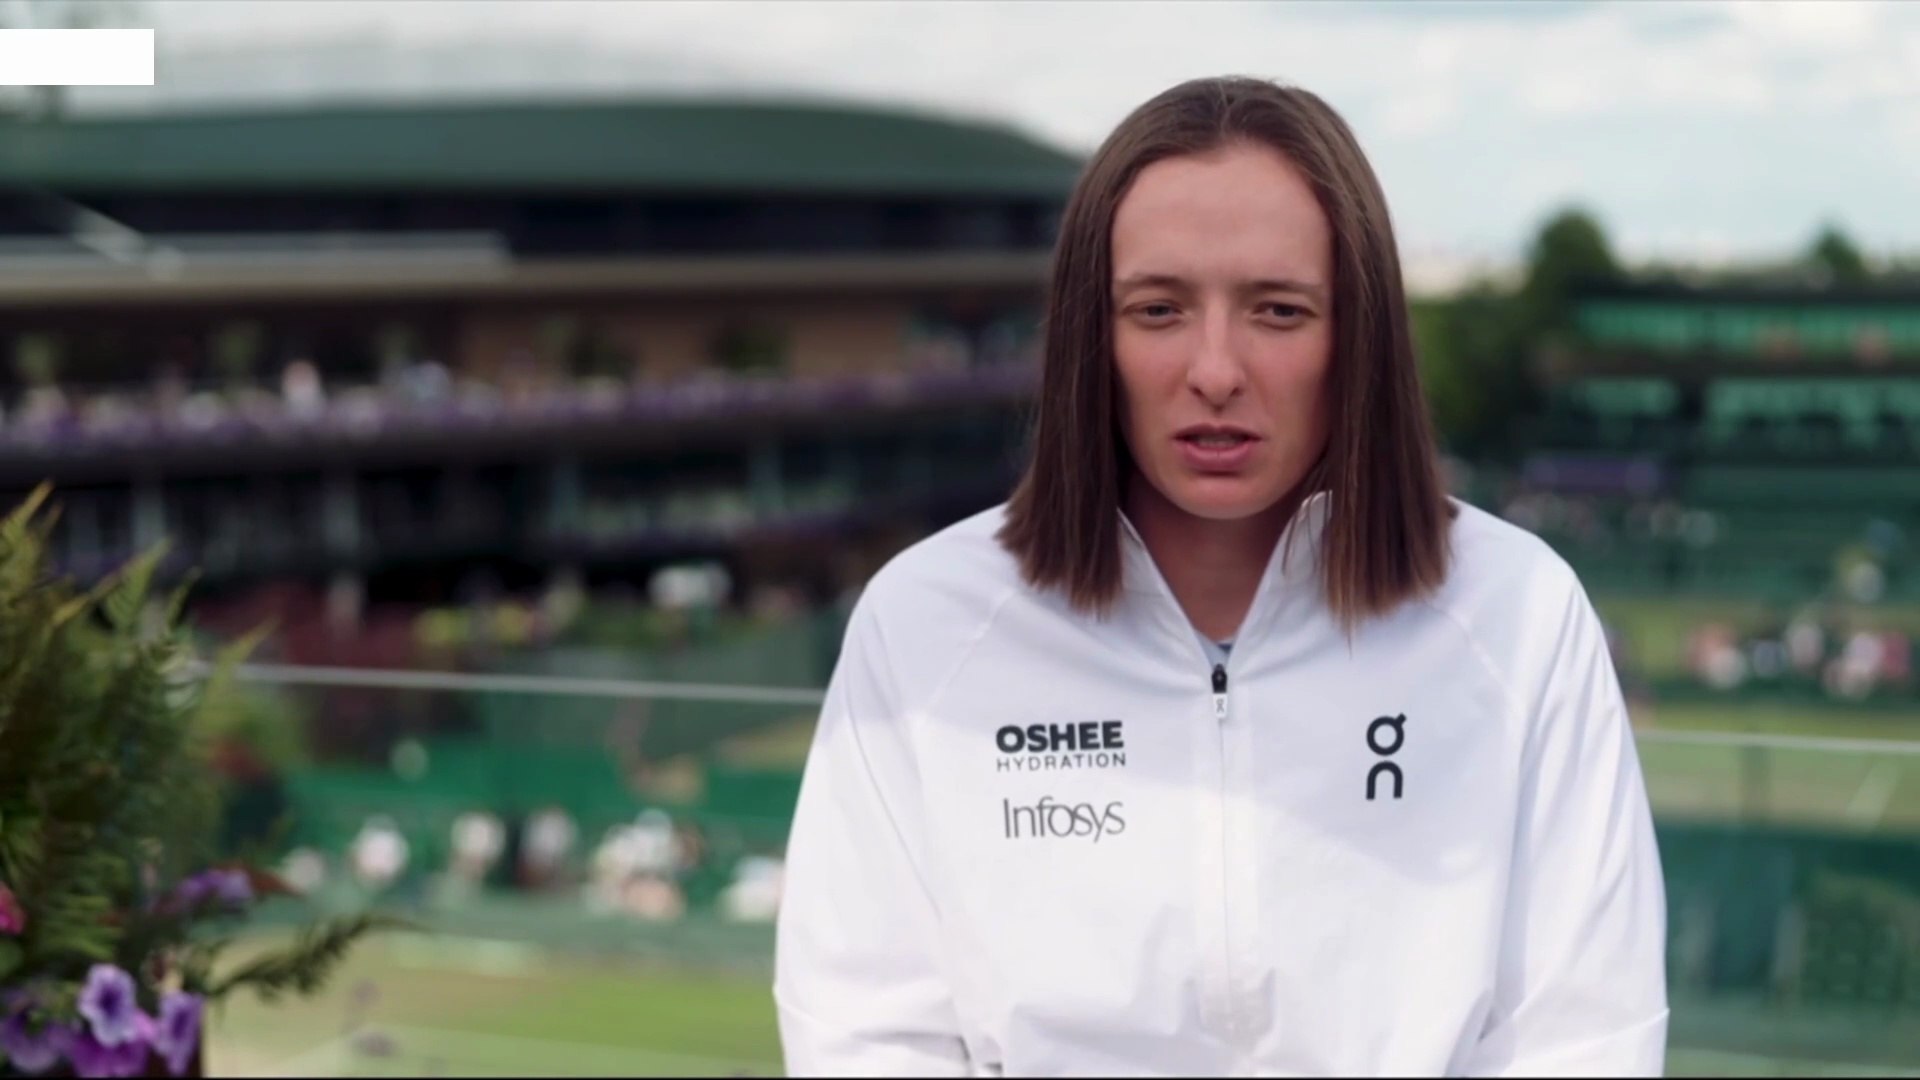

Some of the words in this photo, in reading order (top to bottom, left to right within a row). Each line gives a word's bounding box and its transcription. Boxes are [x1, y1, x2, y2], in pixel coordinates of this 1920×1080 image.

[996, 721, 1125, 753] OSHEE
[996, 753, 1125, 771] HYDRATION
[1003, 796, 1125, 843] Infosys
